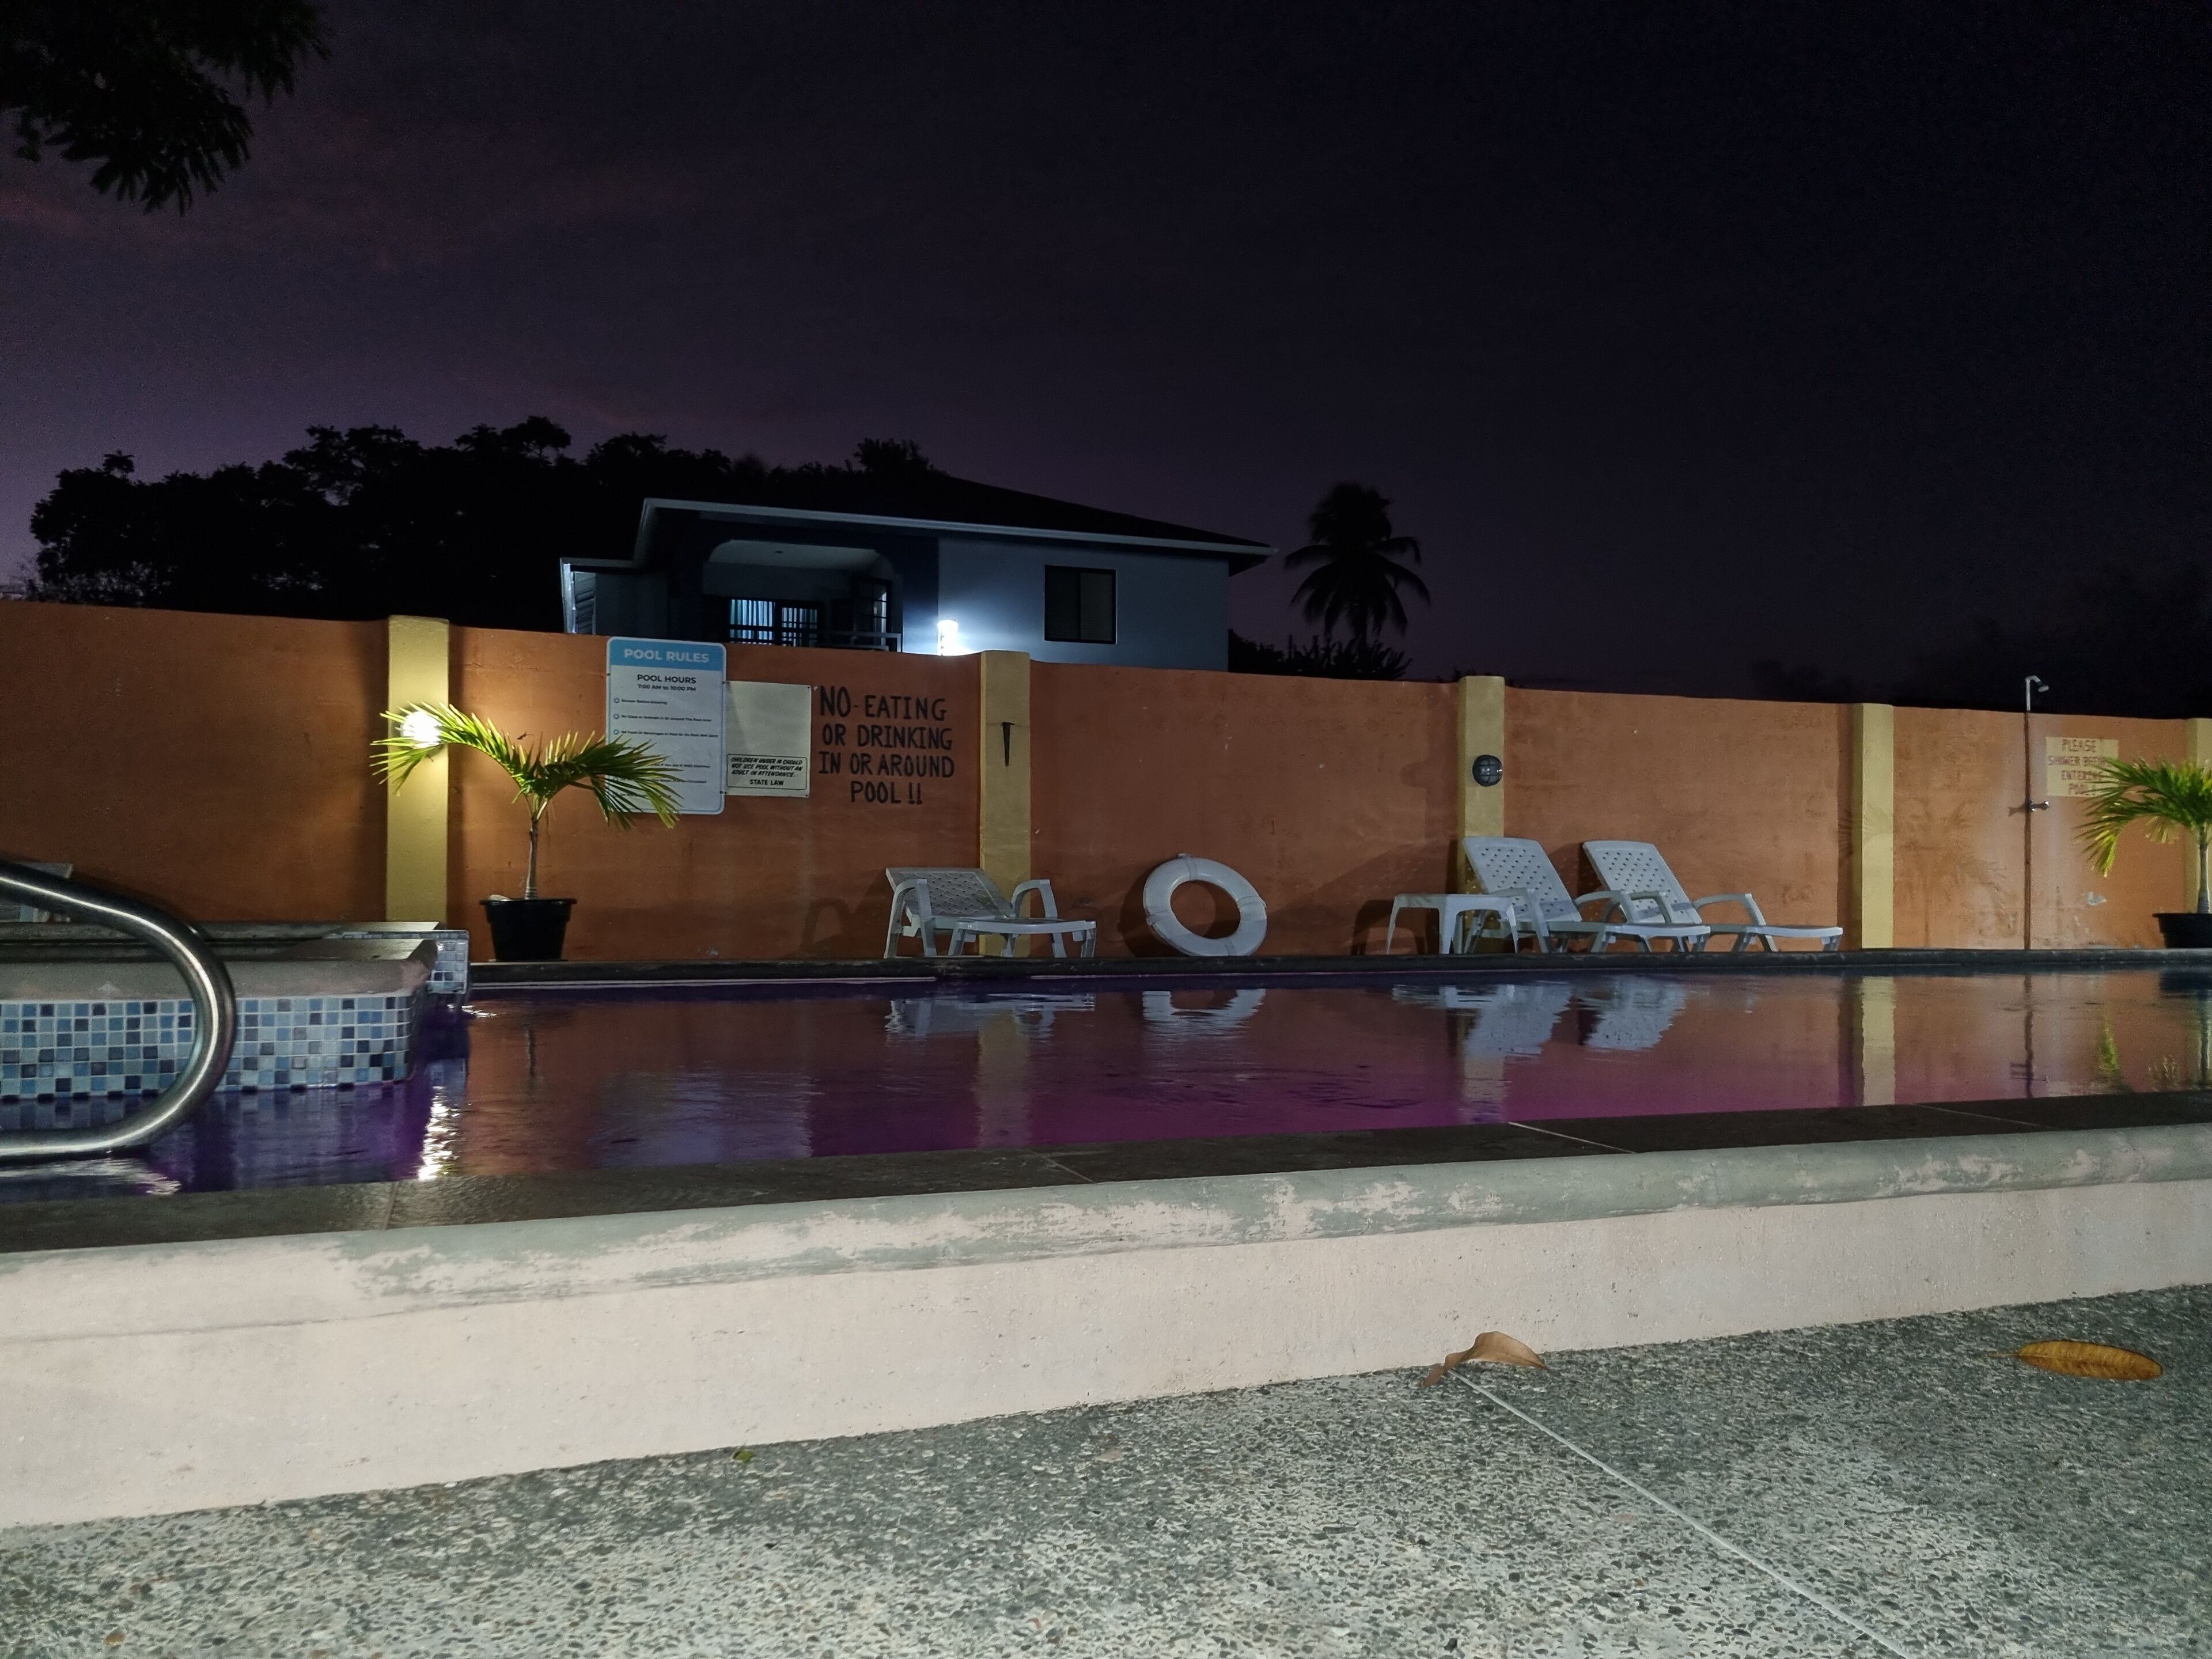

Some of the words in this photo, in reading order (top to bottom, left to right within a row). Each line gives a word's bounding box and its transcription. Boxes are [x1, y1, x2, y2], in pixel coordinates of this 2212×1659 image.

[624, 648, 662, 660] POOL
[666, 651, 709, 662] RULES
[637, 674, 662, 682] POOL
[865, 695, 947, 721] EATING
[822, 724, 847, 746] OR
[857, 725, 953, 751] DRINKING
[2062, 739, 2097, 752] PLEASE
[818, 751, 842, 774] IN
[850, 753, 873, 775] OR
[877, 754, 955, 778] AROUND
[851, 781, 901, 804] POOL
